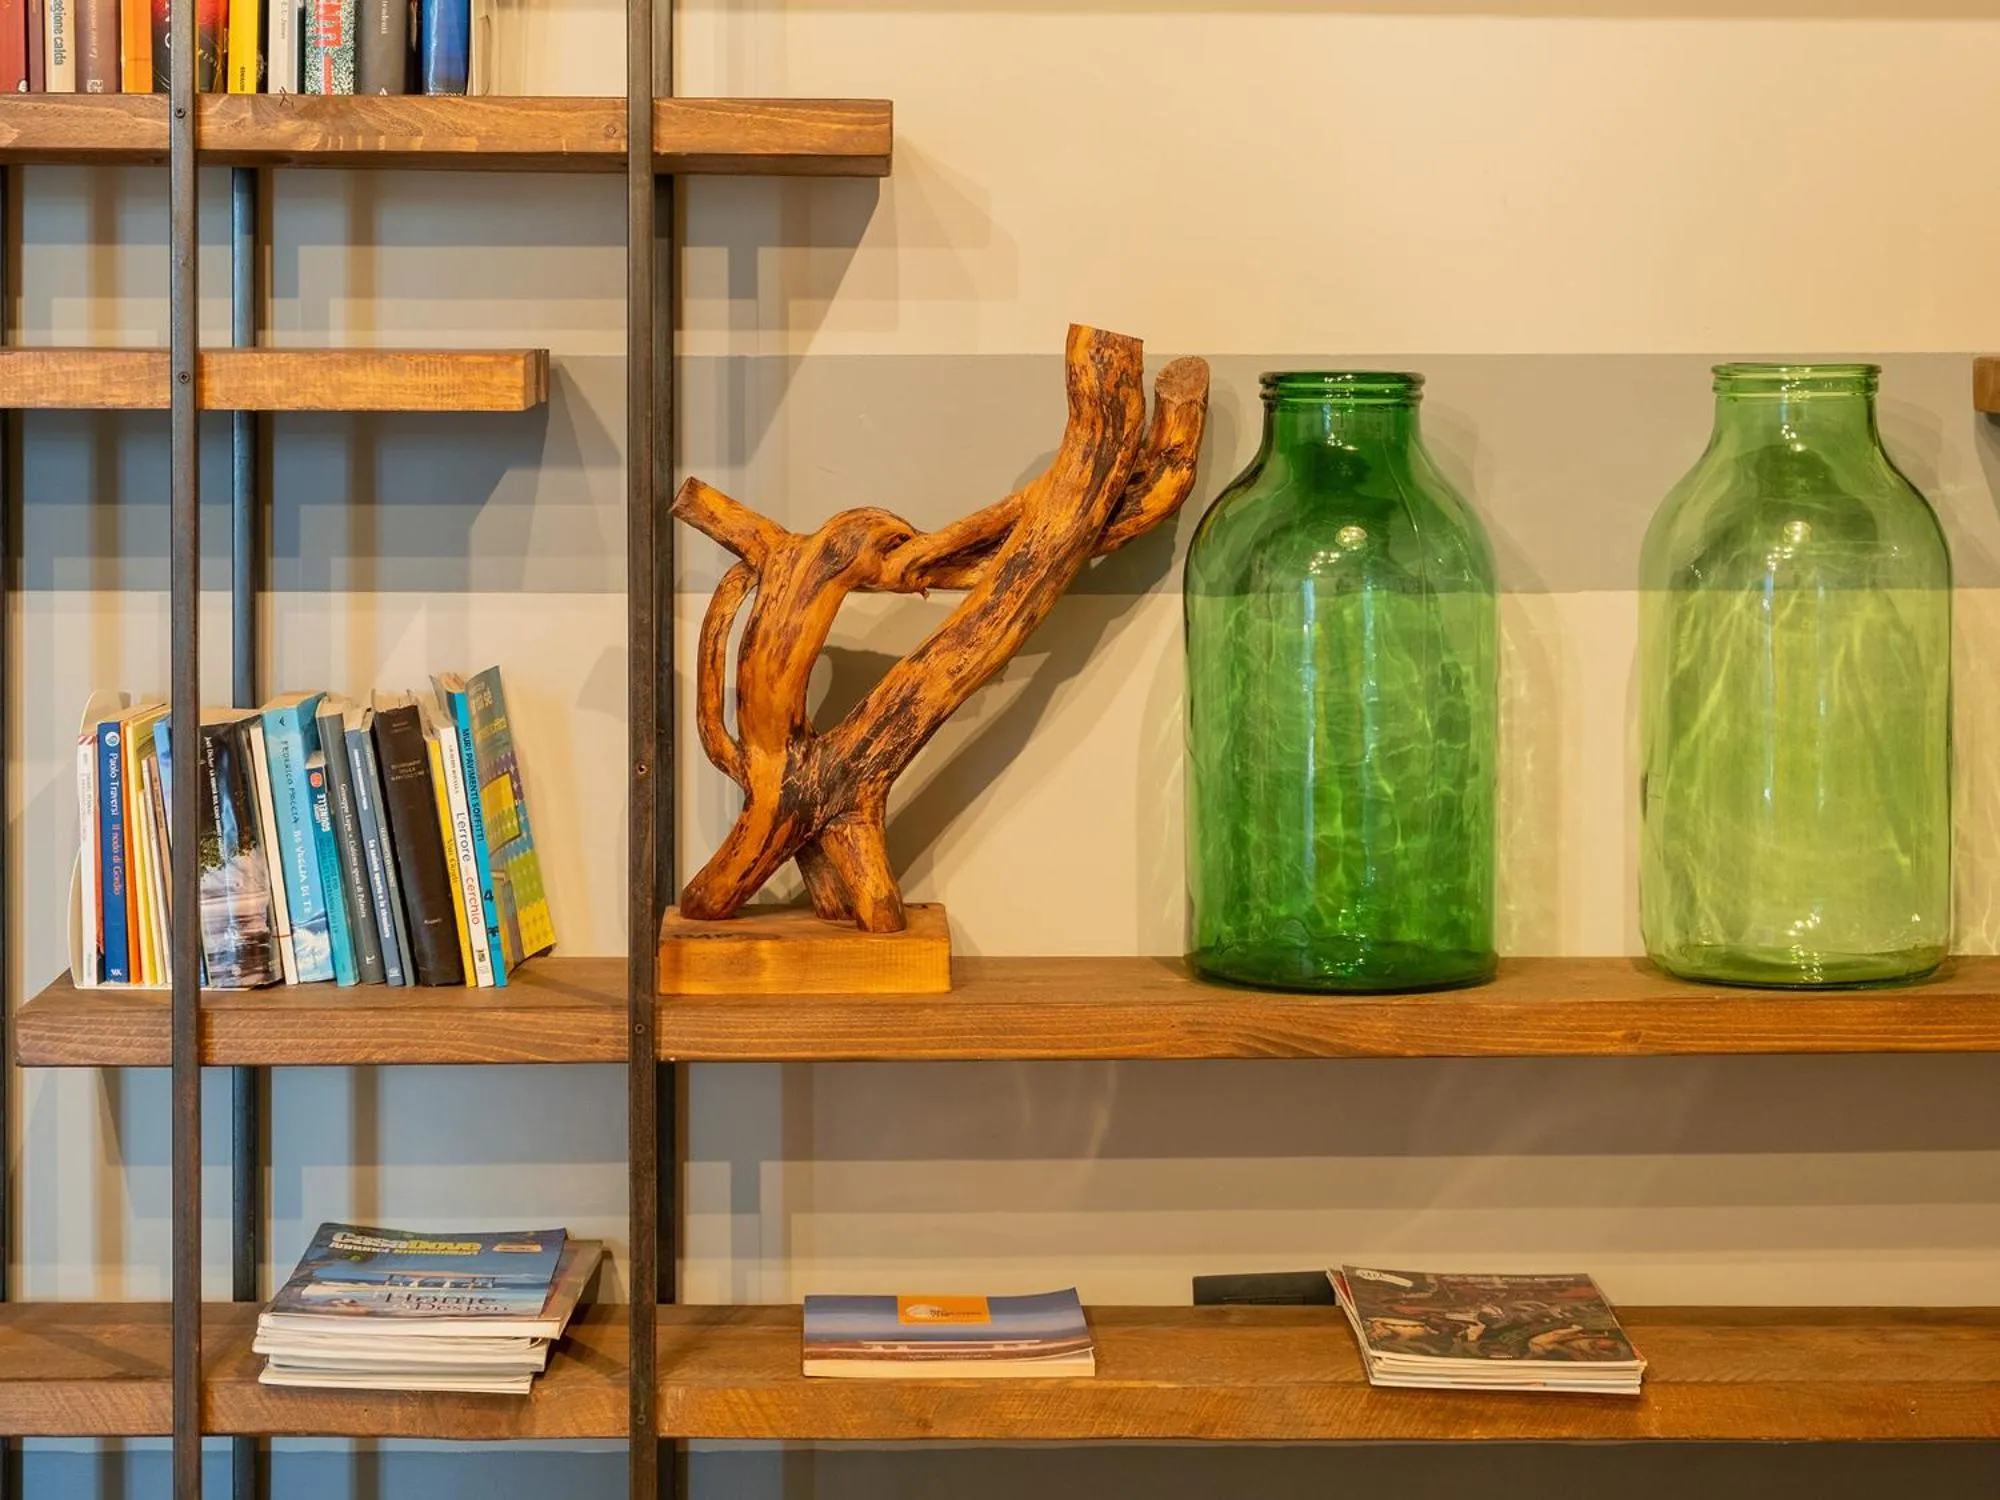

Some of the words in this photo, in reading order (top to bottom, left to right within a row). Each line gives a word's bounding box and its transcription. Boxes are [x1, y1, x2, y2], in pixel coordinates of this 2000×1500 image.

[54, 37, 67, 66] calda
[462, 728, 472, 751] MURI
[108, 752, 119, 778] Paolo
[465, 753, 479, 800] PAVIMENTI
[109, 781, 121, 816] Traversi
[287, 787, 300, 824] MOCCIA
[472, 802, 485, 842] SOFFITTI
[111, 831, 121, 853] nodo
[112, 855, 122, 863] di
[456, 811, 471, 863] L'errore
[465, 876, 481, 925] cerchio
[112, 866, 122, 896] Gordio
[300, 885, 310, 897] DI
[303, 899, 312, 913] TE
[385, 1291, 497, 1305] Home
